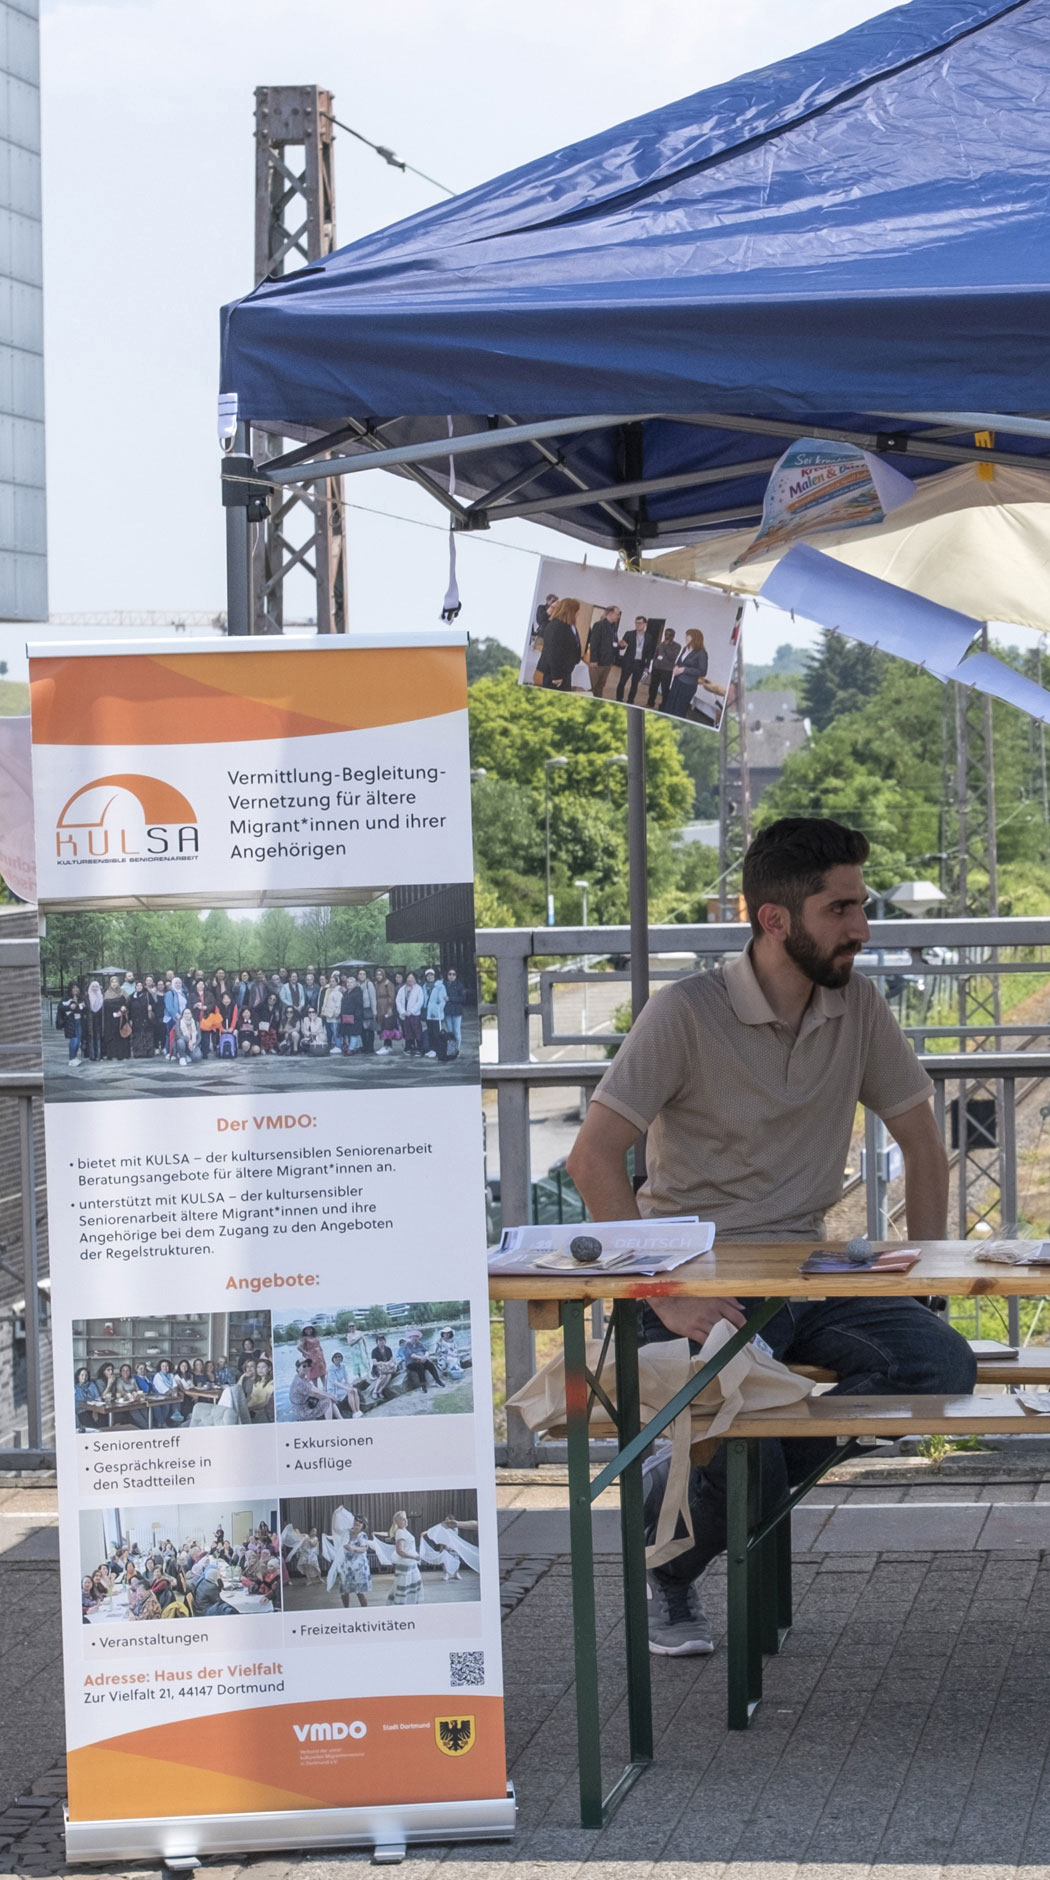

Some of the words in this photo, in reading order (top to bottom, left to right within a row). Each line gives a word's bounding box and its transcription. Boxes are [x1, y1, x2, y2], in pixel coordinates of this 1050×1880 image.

[789, 472, 825, 499] Malen
[227, 765, 446, 787] Vermittlung-Begleitung-
[228, 794, 331, 812] Vernetzung
[336, 790, 361, 807] für
[366, 789, 417, 806] ältere
[365, 813, 400, 831] und
[406, 813, 447, 829] ihrer
[56, 826, 199, 858] KULSA
[230, 841, 346, 863] Angehörigen
[56, 857, 127, 866] KULTURSENSIBLE
[129, 855, 199, 863] SENIORENARBEIT
[216, 1117, 249, 1133] Der
[252, 1113, 317, 1130] VMDO:
[77, 1157, 117, 1170] bietet
[120, 1155, 142, 1167] mit
[145, 1153, 190, 1166] KULSA
[205, 1151, 228, 1164] der
[231, 1146, 332, 1162] kultursensiblen
[335, 1142, 433, 1158] Seniorenarbeit
[78, 1169, 210, 1187] Beratungsangebote
[213, 1167, 232, 1180] für
[235, 1166, 273, 1179] ältere
[376, 1163, 396, 1173] an.
[79, 1196, 152, 1210] unterstützt
[155, 1195, 177, 1206] mit
[180, 1192, 225, 1205] KULSA
[240, 1190, 263, 1202] der
[266, 1185, 364, 1201] kultursensibler
[79, 1211, 177, 1227] Seniorenarbeit
[180, 1209, 219, 1222] ältere
[322, 1202, 348, 1215] und
[351, 1201, 377, 1214] ihre
[79, 1229, 158, 1246] Angehörige
[160, 1227, 182, 1240] bei
[184, 1226, 215, 1239] dem
[218, 1225, 269, 1239] Zugang
[272, 1225, 288, 1234] zu
[291, 1221, 317, 1234] den
[320, 1218, 394, 1234] Angeboten
[79, 1248, 103, 1261] der
[106, 1244, 215, 1262] Regelstrukturen.
[615, 1238, 692, 1249] DEUTSCH
[225, 1272, 320, 1294] Angebote:
[93, 1435, 181, 1453] Seniorentreff
[293, 1436, 374, 1450] Exkursionen
[93, 1457, 196, 1476] Gesprächkreise
[199, 1456, 212, 1468] in
[294, 1457, 353, 1472] Ausflüge
[93, 1478, 119, 1491] den
[123, 1474, 195, 1489] Stadtteilen
[300, 1619, 416, 1637] Freizeitaktivitäten
[99, 1633, 209, 1649] Veranstaltungen
[83, 1672, 150, 1687] Adresse:
[154, 1669, 193, 1682] Haus
[197, 1666, 224, 1680] der
[227, 1662, 284, 1678] Vielfalt
[84, 1692, 106, 1704] Zur
[108, 1688, 156, 1702] Vielfalt
[159, 1688, 175, 1701] 21,
[178, 1685, 214, 1698] 44147
[217, 1679, 285, 1696] Dortmund
